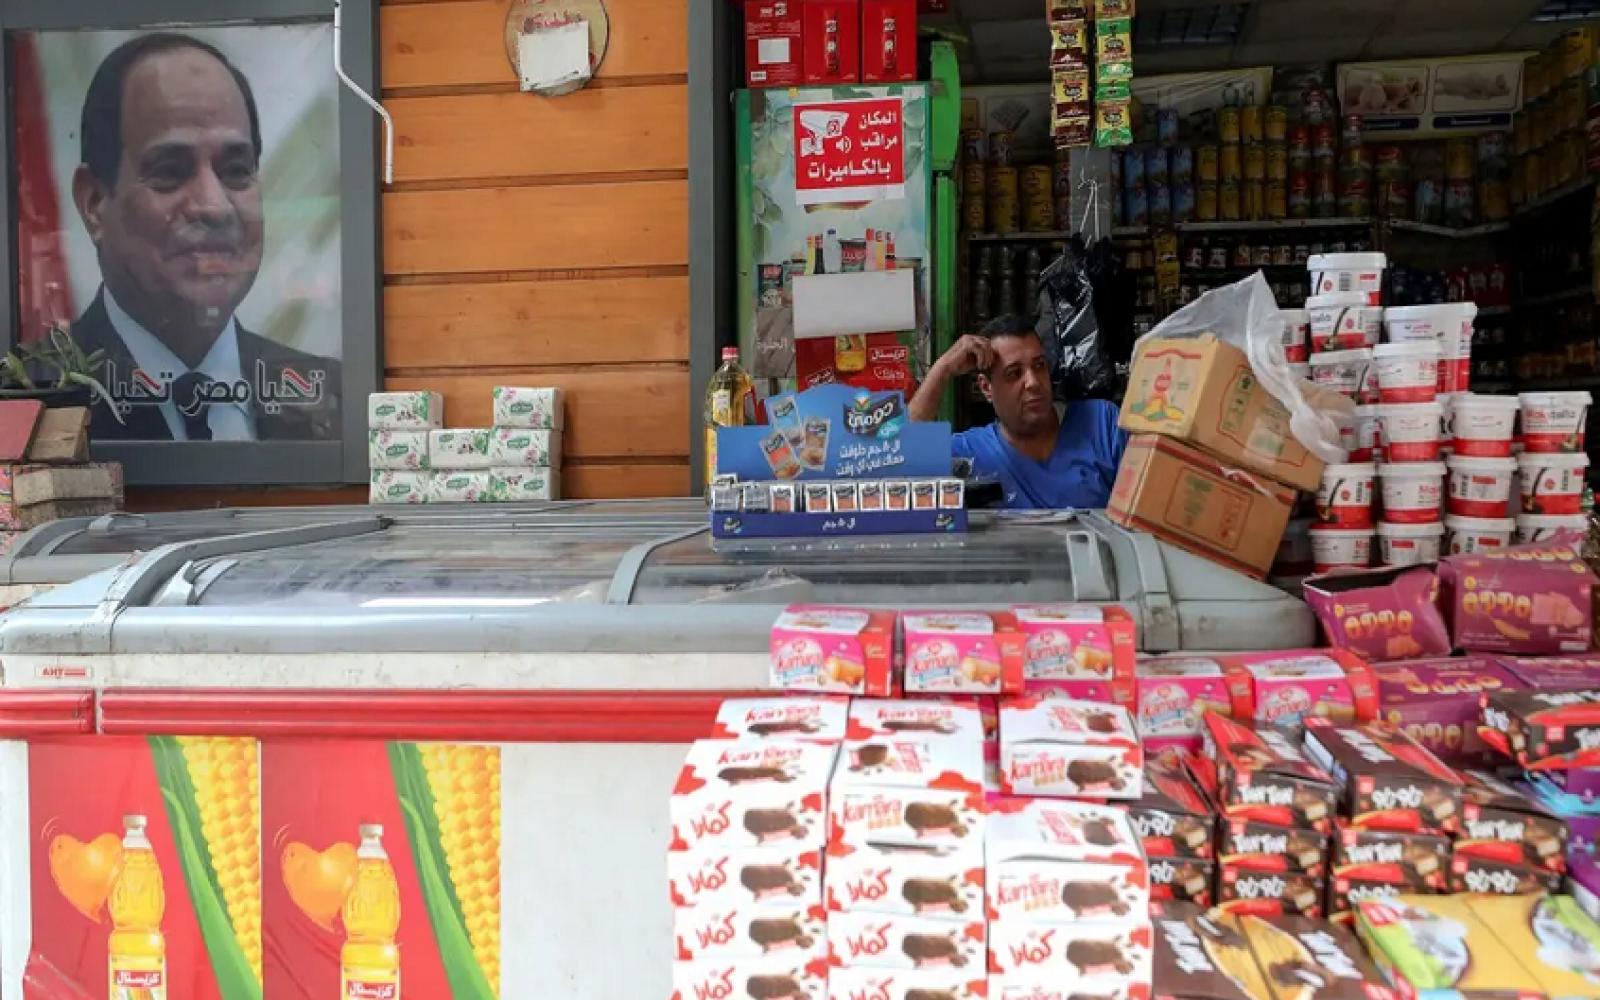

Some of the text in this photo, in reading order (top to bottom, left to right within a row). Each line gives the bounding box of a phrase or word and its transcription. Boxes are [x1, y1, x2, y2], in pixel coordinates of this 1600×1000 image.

[858, 112, 897, 130] المكان
[860, 136, 898, 151] مراقب
[808, 159, 892, 182] بالكاميرات
[106, 358, 326, 416] تحيا مصر تحيا
[117, 972, 160, 987] كريستال
[349, 983, 394, 998] كريستال
